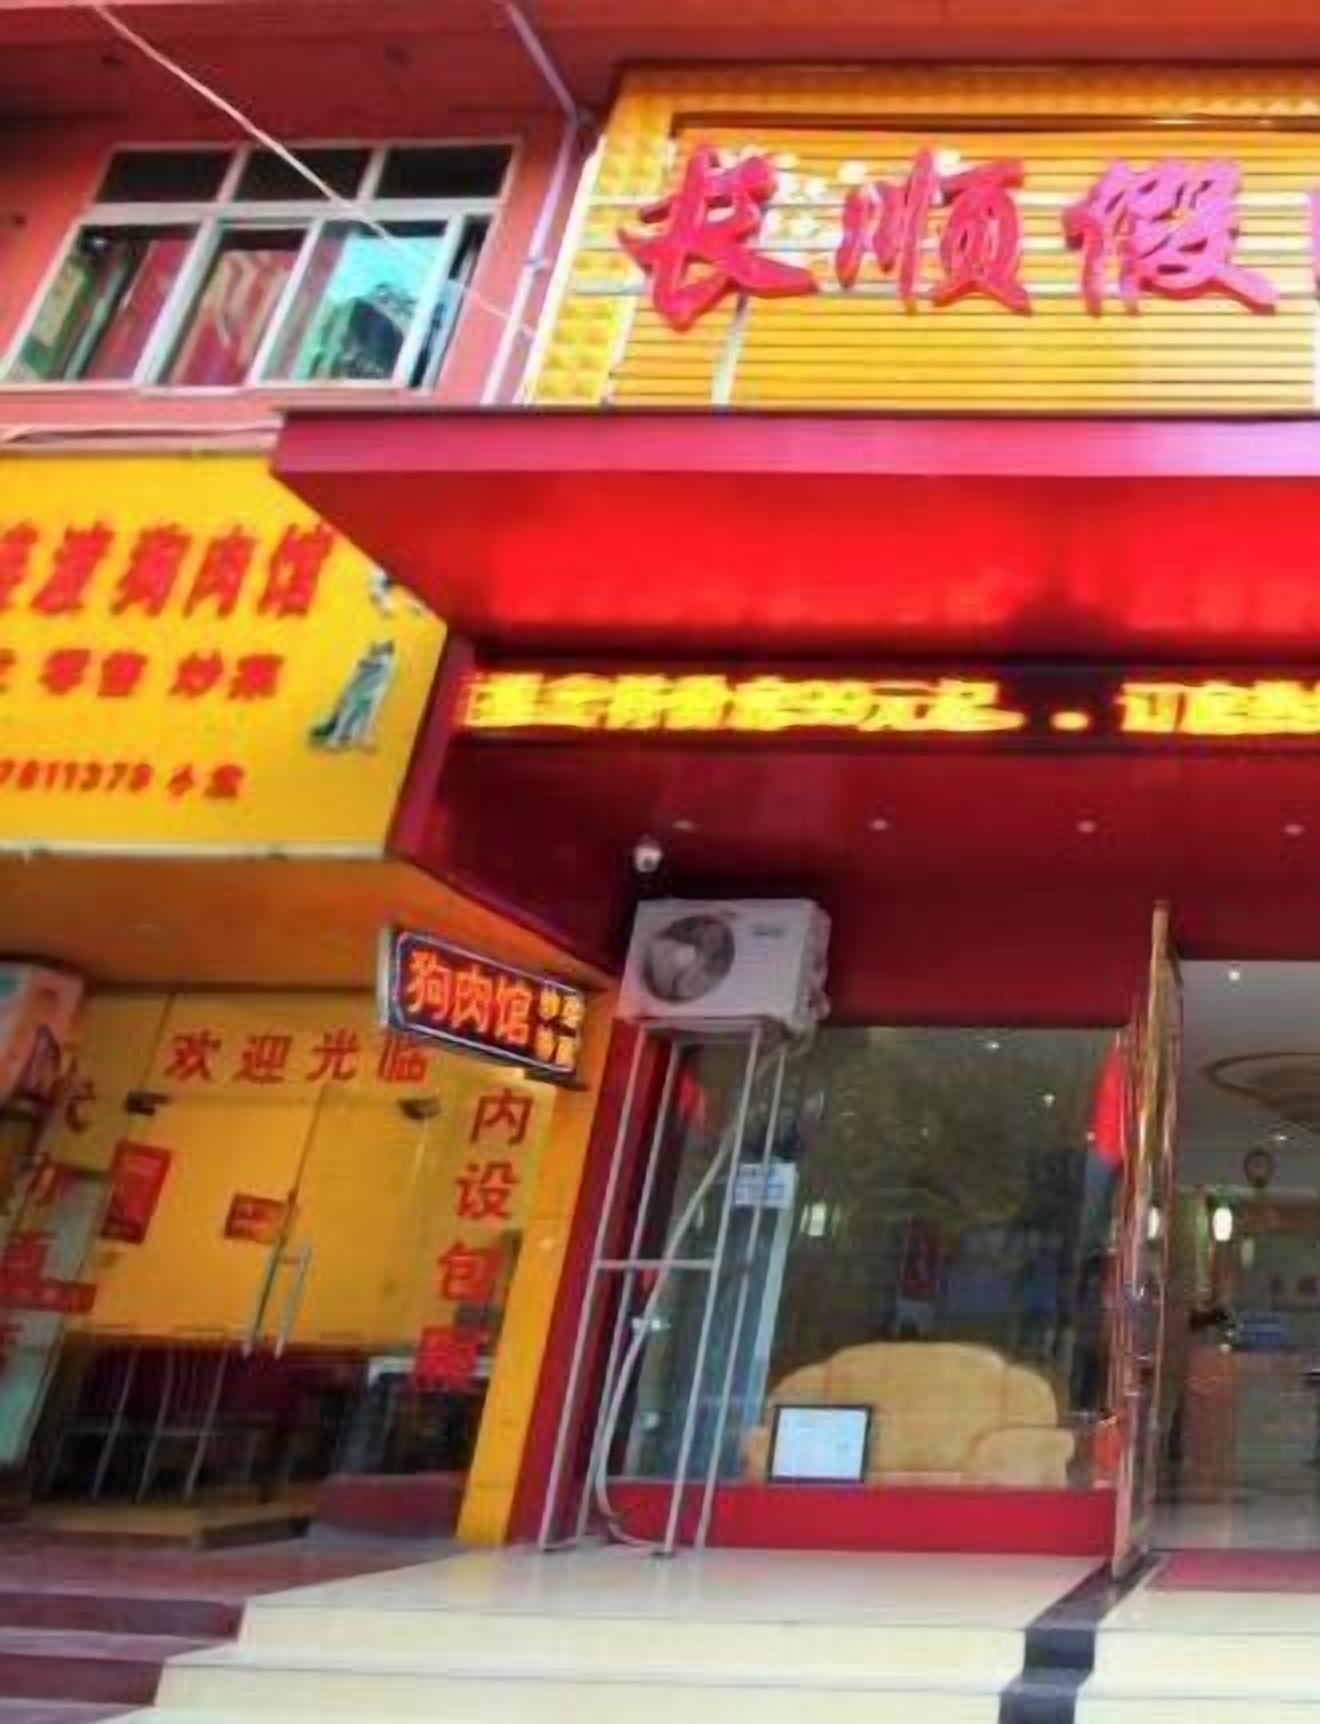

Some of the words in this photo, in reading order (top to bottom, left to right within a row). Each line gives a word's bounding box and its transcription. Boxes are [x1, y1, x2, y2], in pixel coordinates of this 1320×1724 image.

[406, 948, 533, 1046] 狗肉馆
[164, 1029, 430, 1083] 欢迎光临
